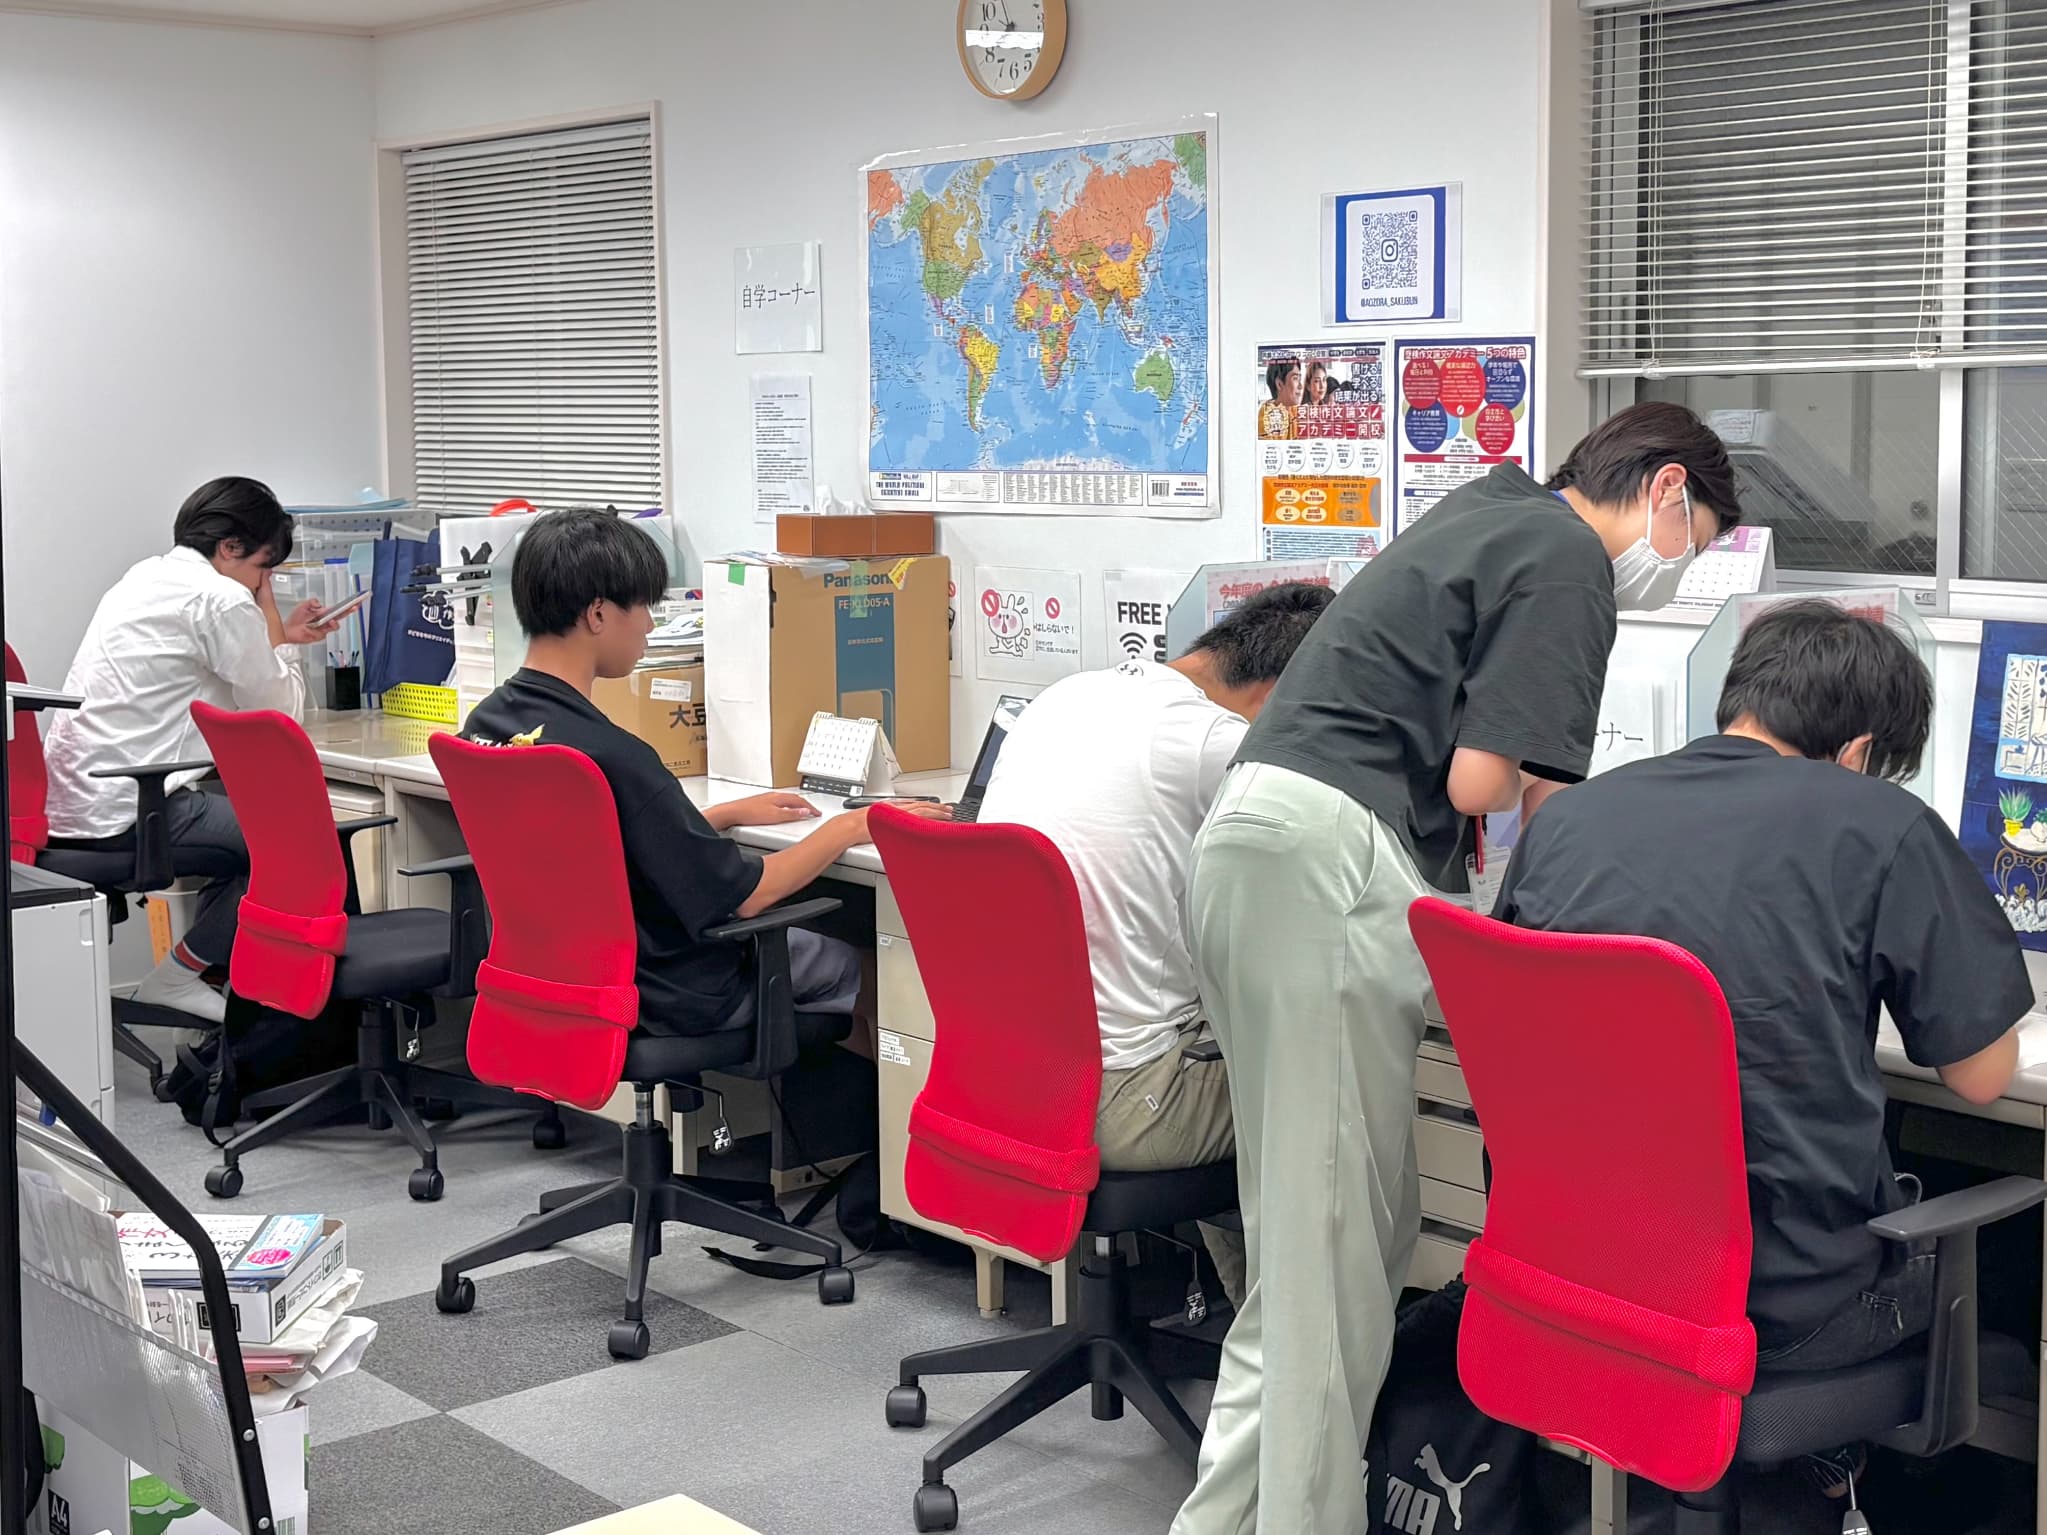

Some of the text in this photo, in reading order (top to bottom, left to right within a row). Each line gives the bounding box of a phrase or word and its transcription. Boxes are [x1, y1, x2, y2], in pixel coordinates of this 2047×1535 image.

[743, 282, 815, 309] 自学コーナー
[824, 573, 894, 588] Panason
[1117, 601, 1162, 625] FREE
[51, 1494, 67, 1528] A4
[1383, 1474, 1441, 1535] MA
